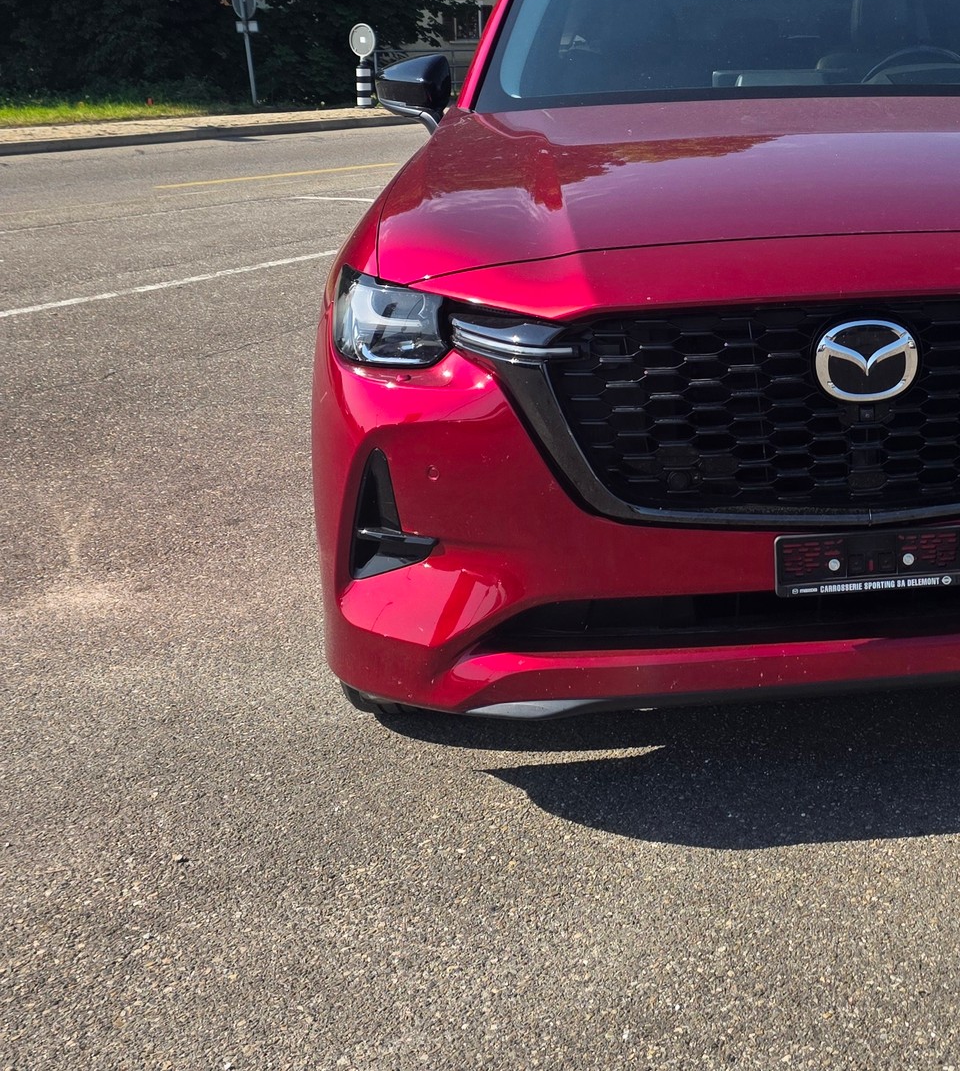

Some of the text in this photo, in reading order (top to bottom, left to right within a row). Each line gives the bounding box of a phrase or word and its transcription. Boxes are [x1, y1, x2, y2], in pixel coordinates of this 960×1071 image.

[820, 582, 862, 593] CARROSSERIE
[864, 580, 896, 590] SPORTING
[897, 578, 906, 588] SA
[907, 577, 940, 587] DELEMONT
